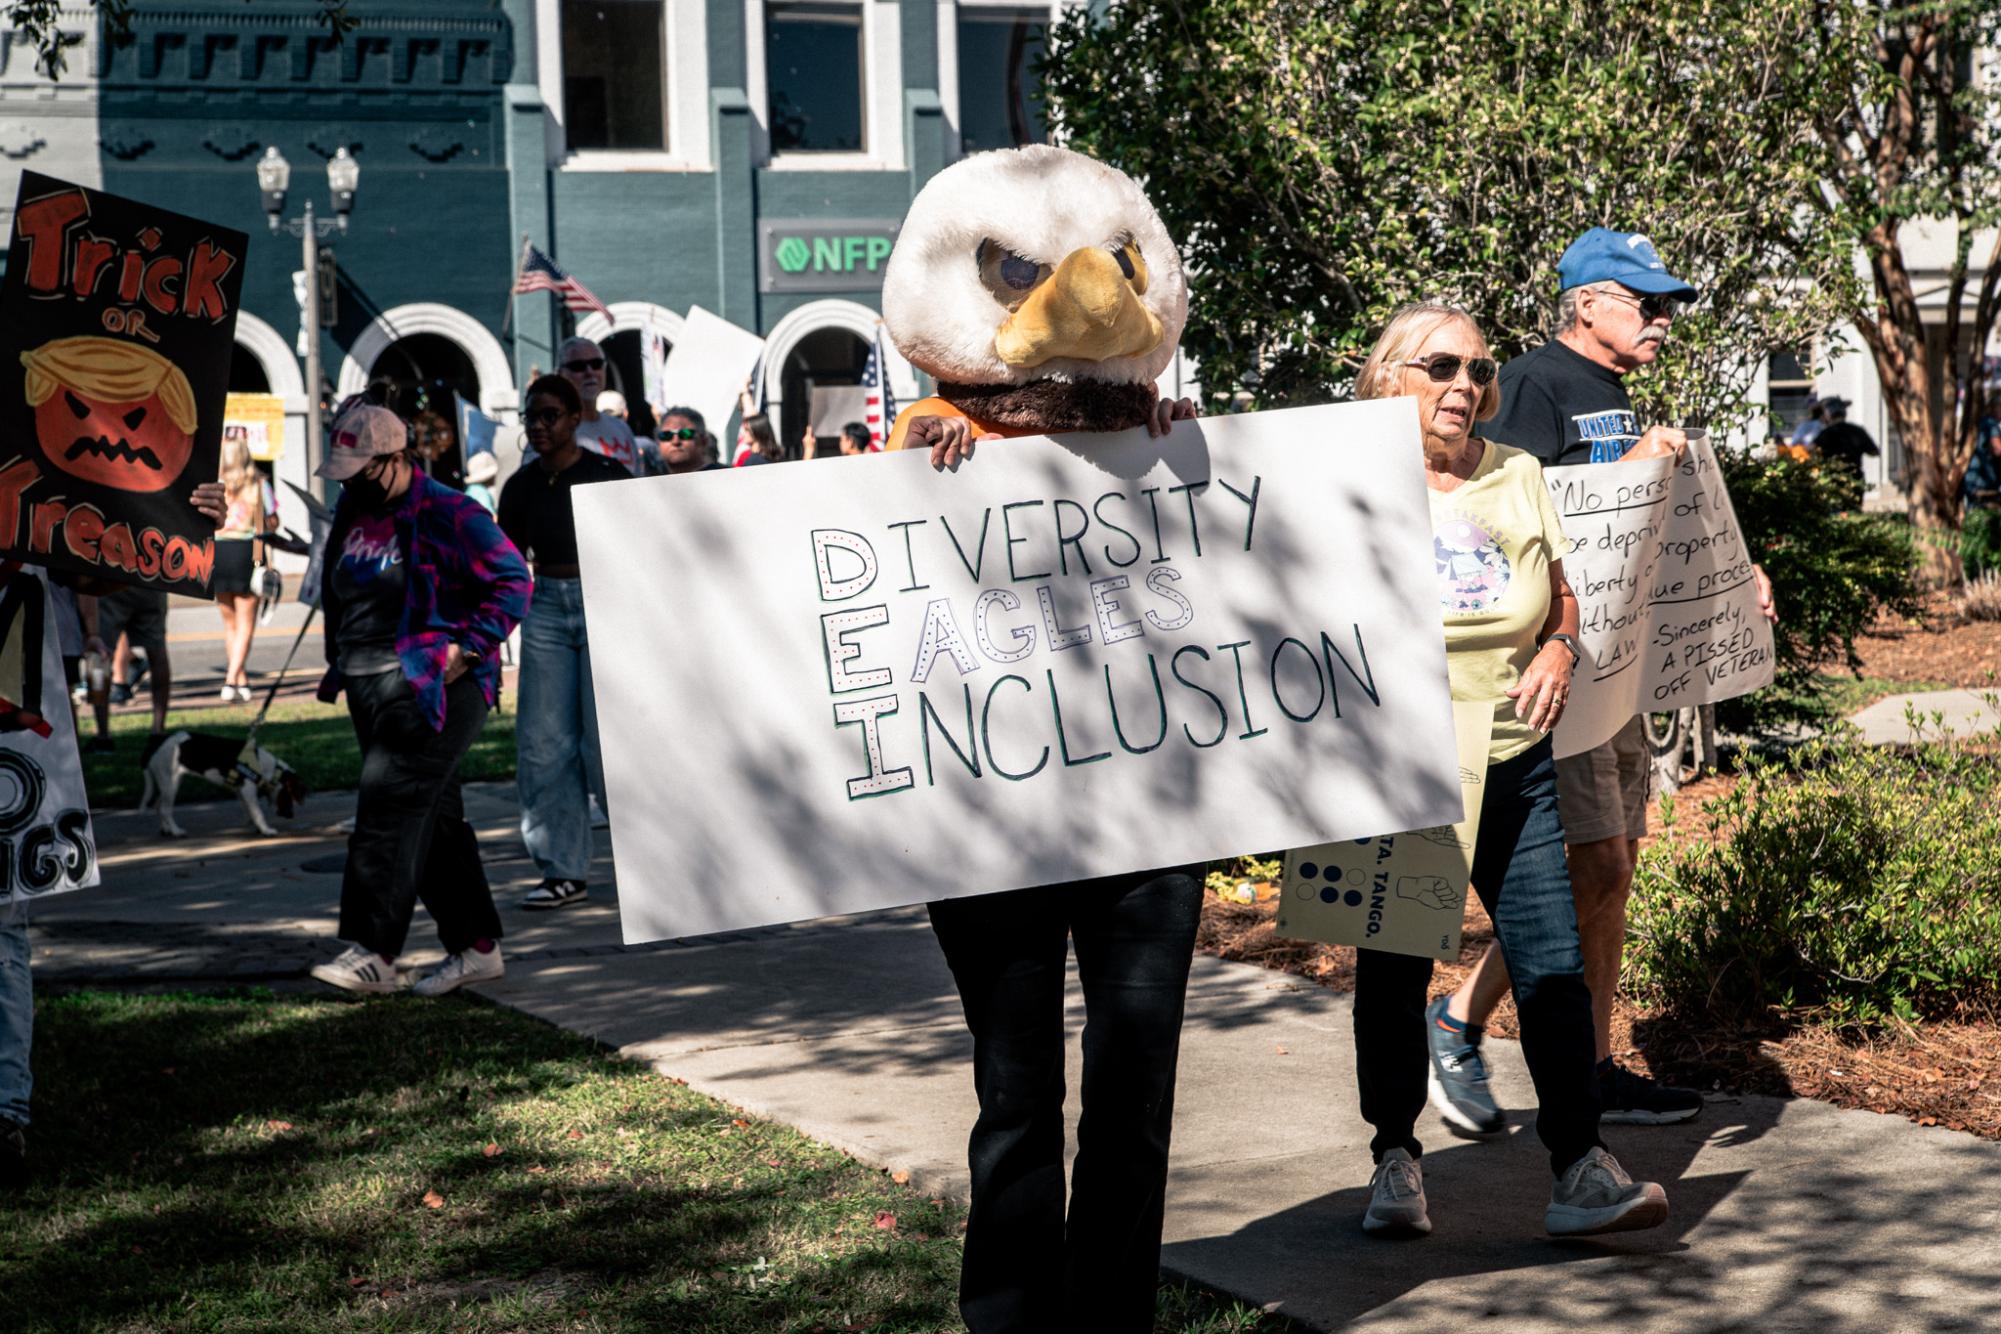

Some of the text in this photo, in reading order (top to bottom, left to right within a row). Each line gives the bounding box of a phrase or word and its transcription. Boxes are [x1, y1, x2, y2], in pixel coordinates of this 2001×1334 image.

[18, 187, 236, 324] Trick
[813, 236, 892, 272] NFP
[102, 306, 160, 342] OR
[1577, 414, 1624, 438] UNITED
[1674, 491, 1704, 517] of
[811, 476, 1261, 601] DIVERSITY
[1566, 564, 1638, 605] iberty
[820, 567, 1193, 693] EAGLES
[1661, 627, 1754, 673] A PISSED
[1654, 670, 1691, 700] OFF
[832, 623, 1380, 800] INCLUSION
[1365, 835, 1394, 938] TA. TANGO.
